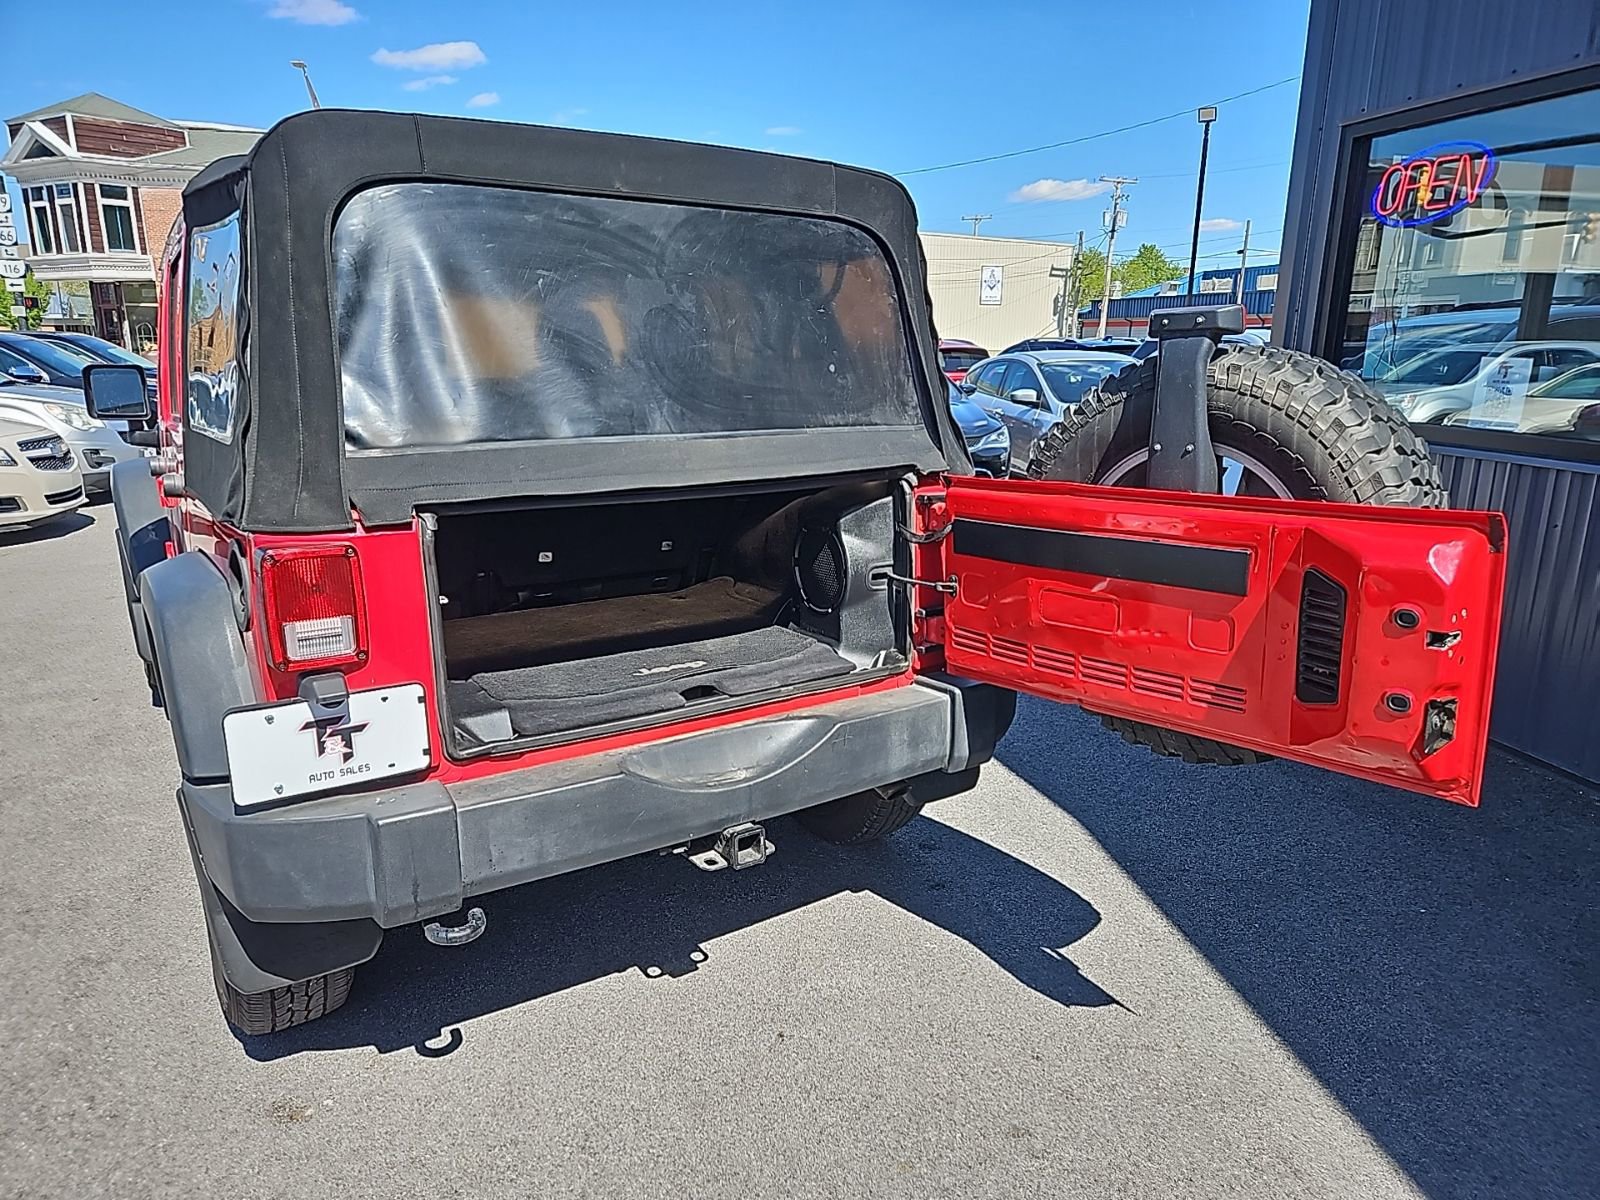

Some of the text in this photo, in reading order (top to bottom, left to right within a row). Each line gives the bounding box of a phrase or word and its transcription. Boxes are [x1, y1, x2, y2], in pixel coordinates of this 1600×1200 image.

[1376, 154, 1489, 215] OPEN
[3, 264, 21, 274] 116
[309, 762, 371, 784] AUTO SALES
